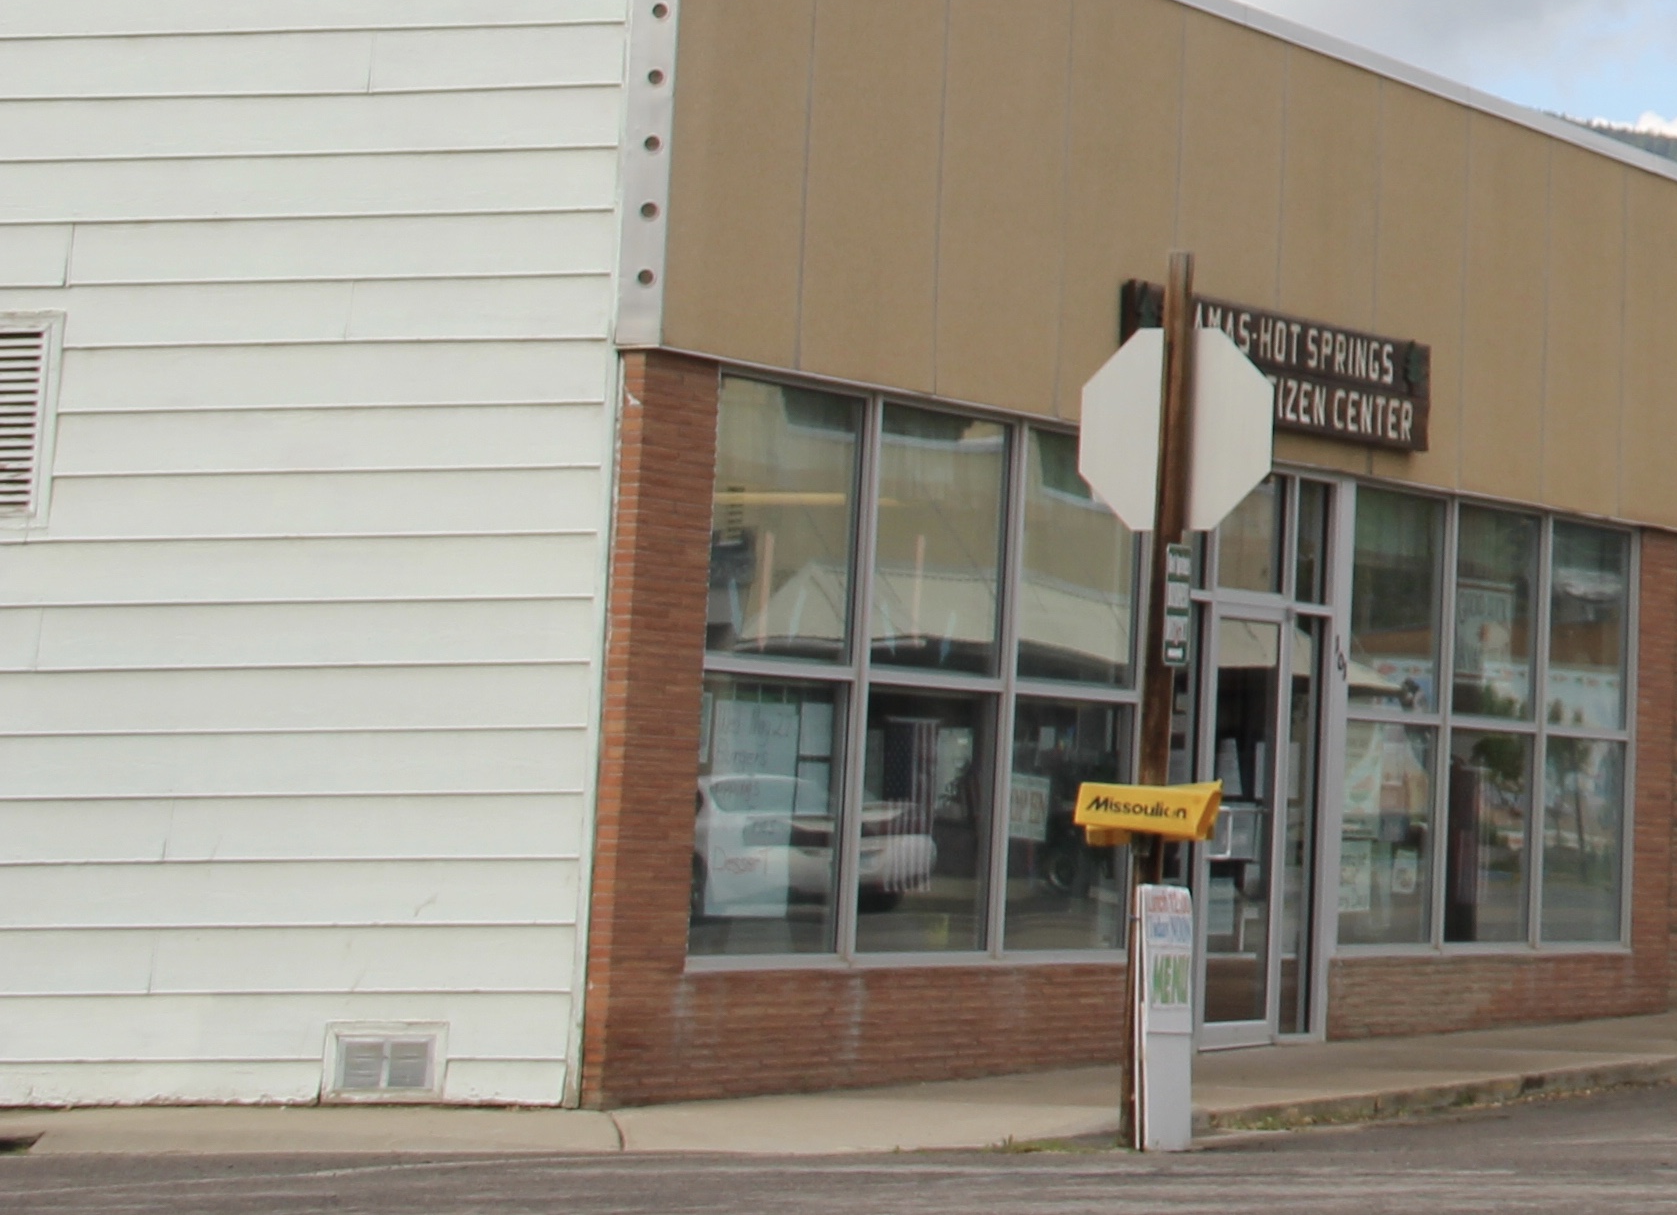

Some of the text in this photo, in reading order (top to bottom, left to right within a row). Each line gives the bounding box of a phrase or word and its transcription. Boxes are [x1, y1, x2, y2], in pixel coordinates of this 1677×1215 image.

[1194, 302, 1394, 385] AMAS-HOT SPRINGS
[1333, 388, 1413, 441] CENTER
